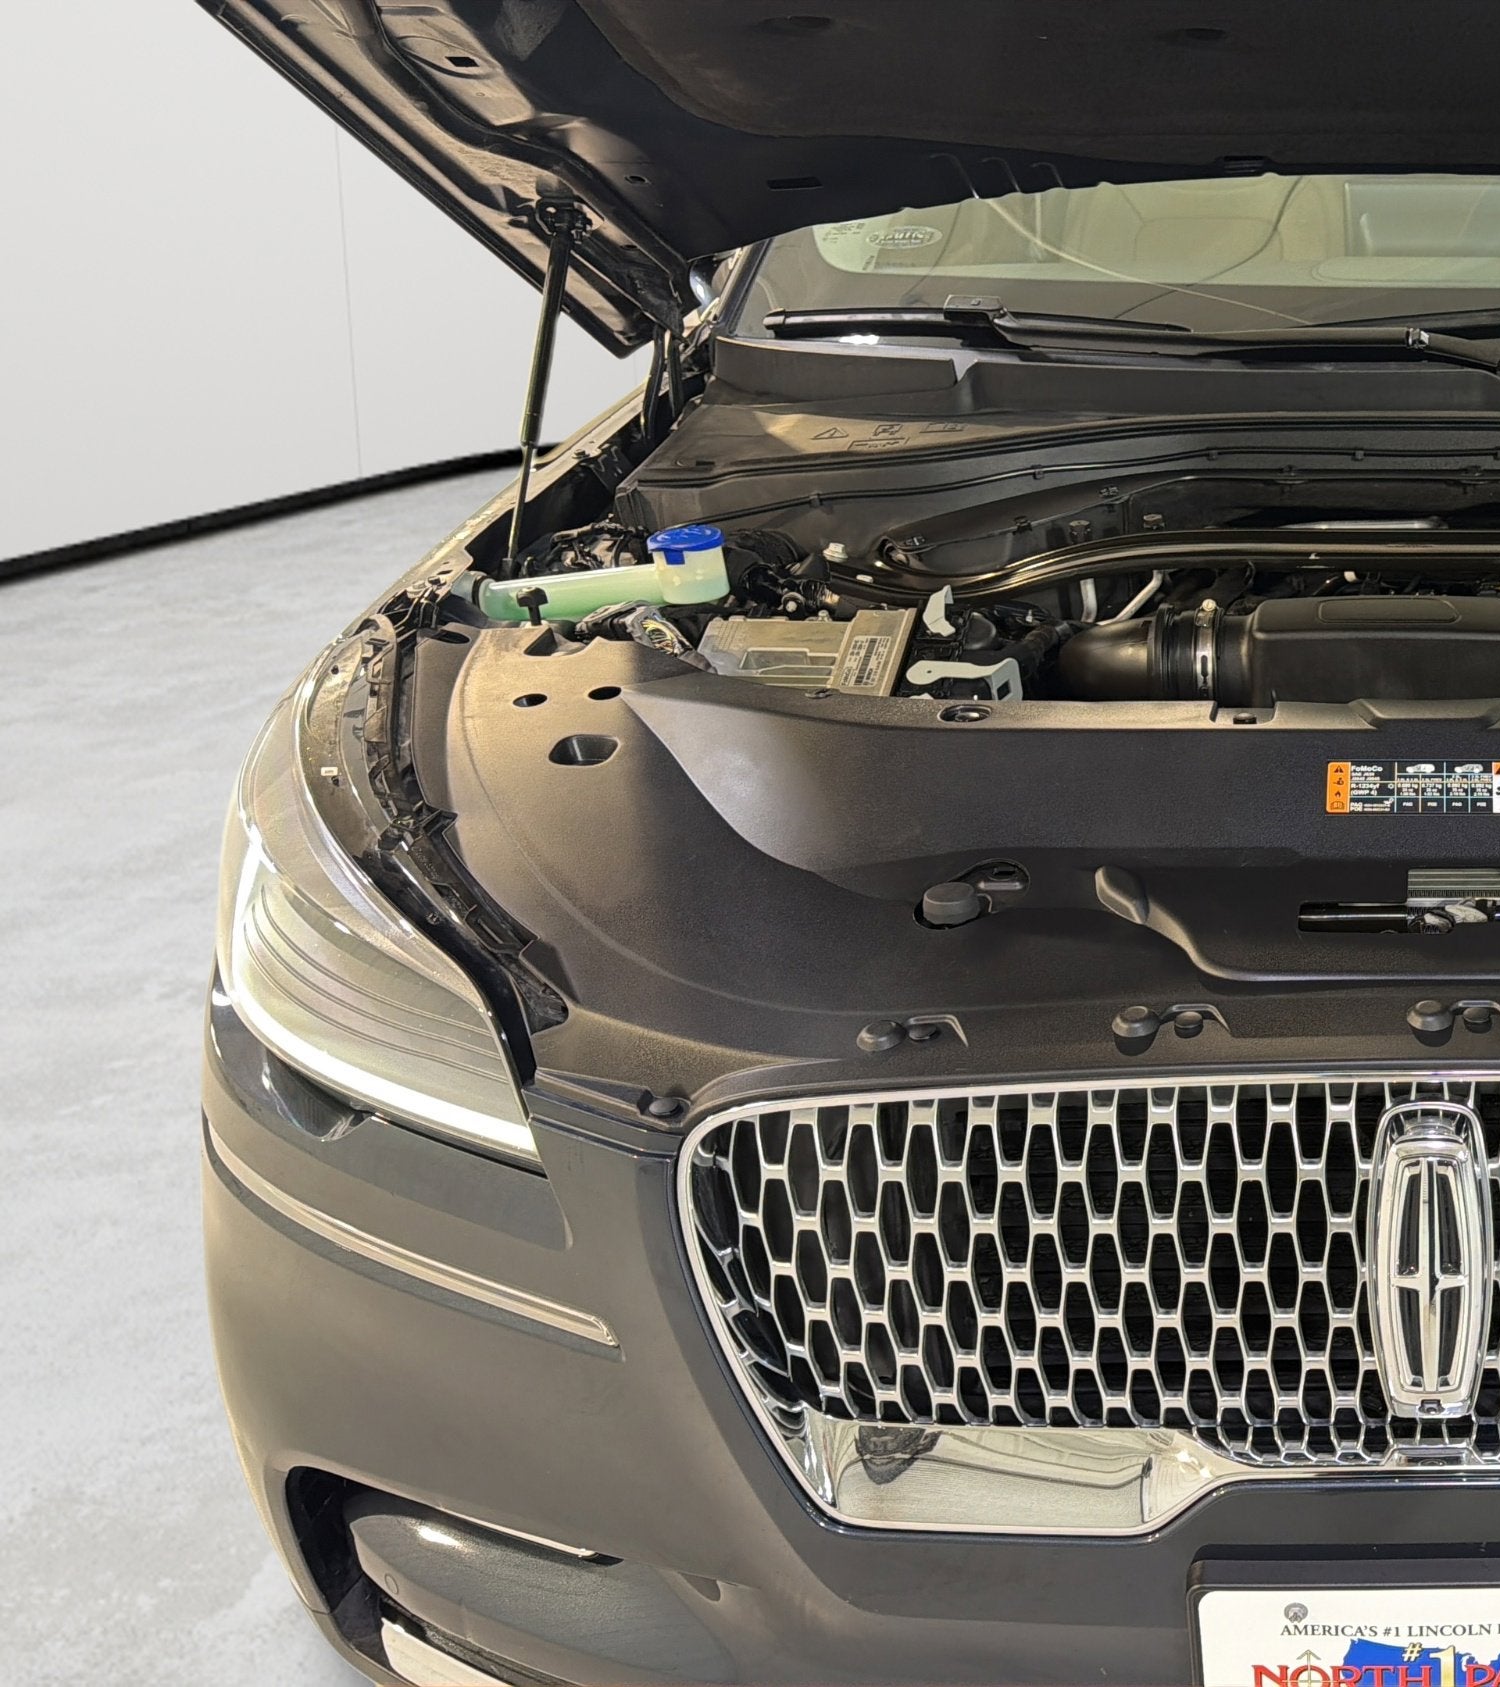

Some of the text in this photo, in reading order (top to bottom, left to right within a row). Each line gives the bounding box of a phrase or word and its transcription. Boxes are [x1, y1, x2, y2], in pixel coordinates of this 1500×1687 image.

[1280, 1624, 1379, 1637] AMERICA'S
[1383, 1626, 1400, 1637] #1
[1407, 1624, 1492, 1637] LINCOLN
[1251, 1664, 1433, 1687] NORTH
